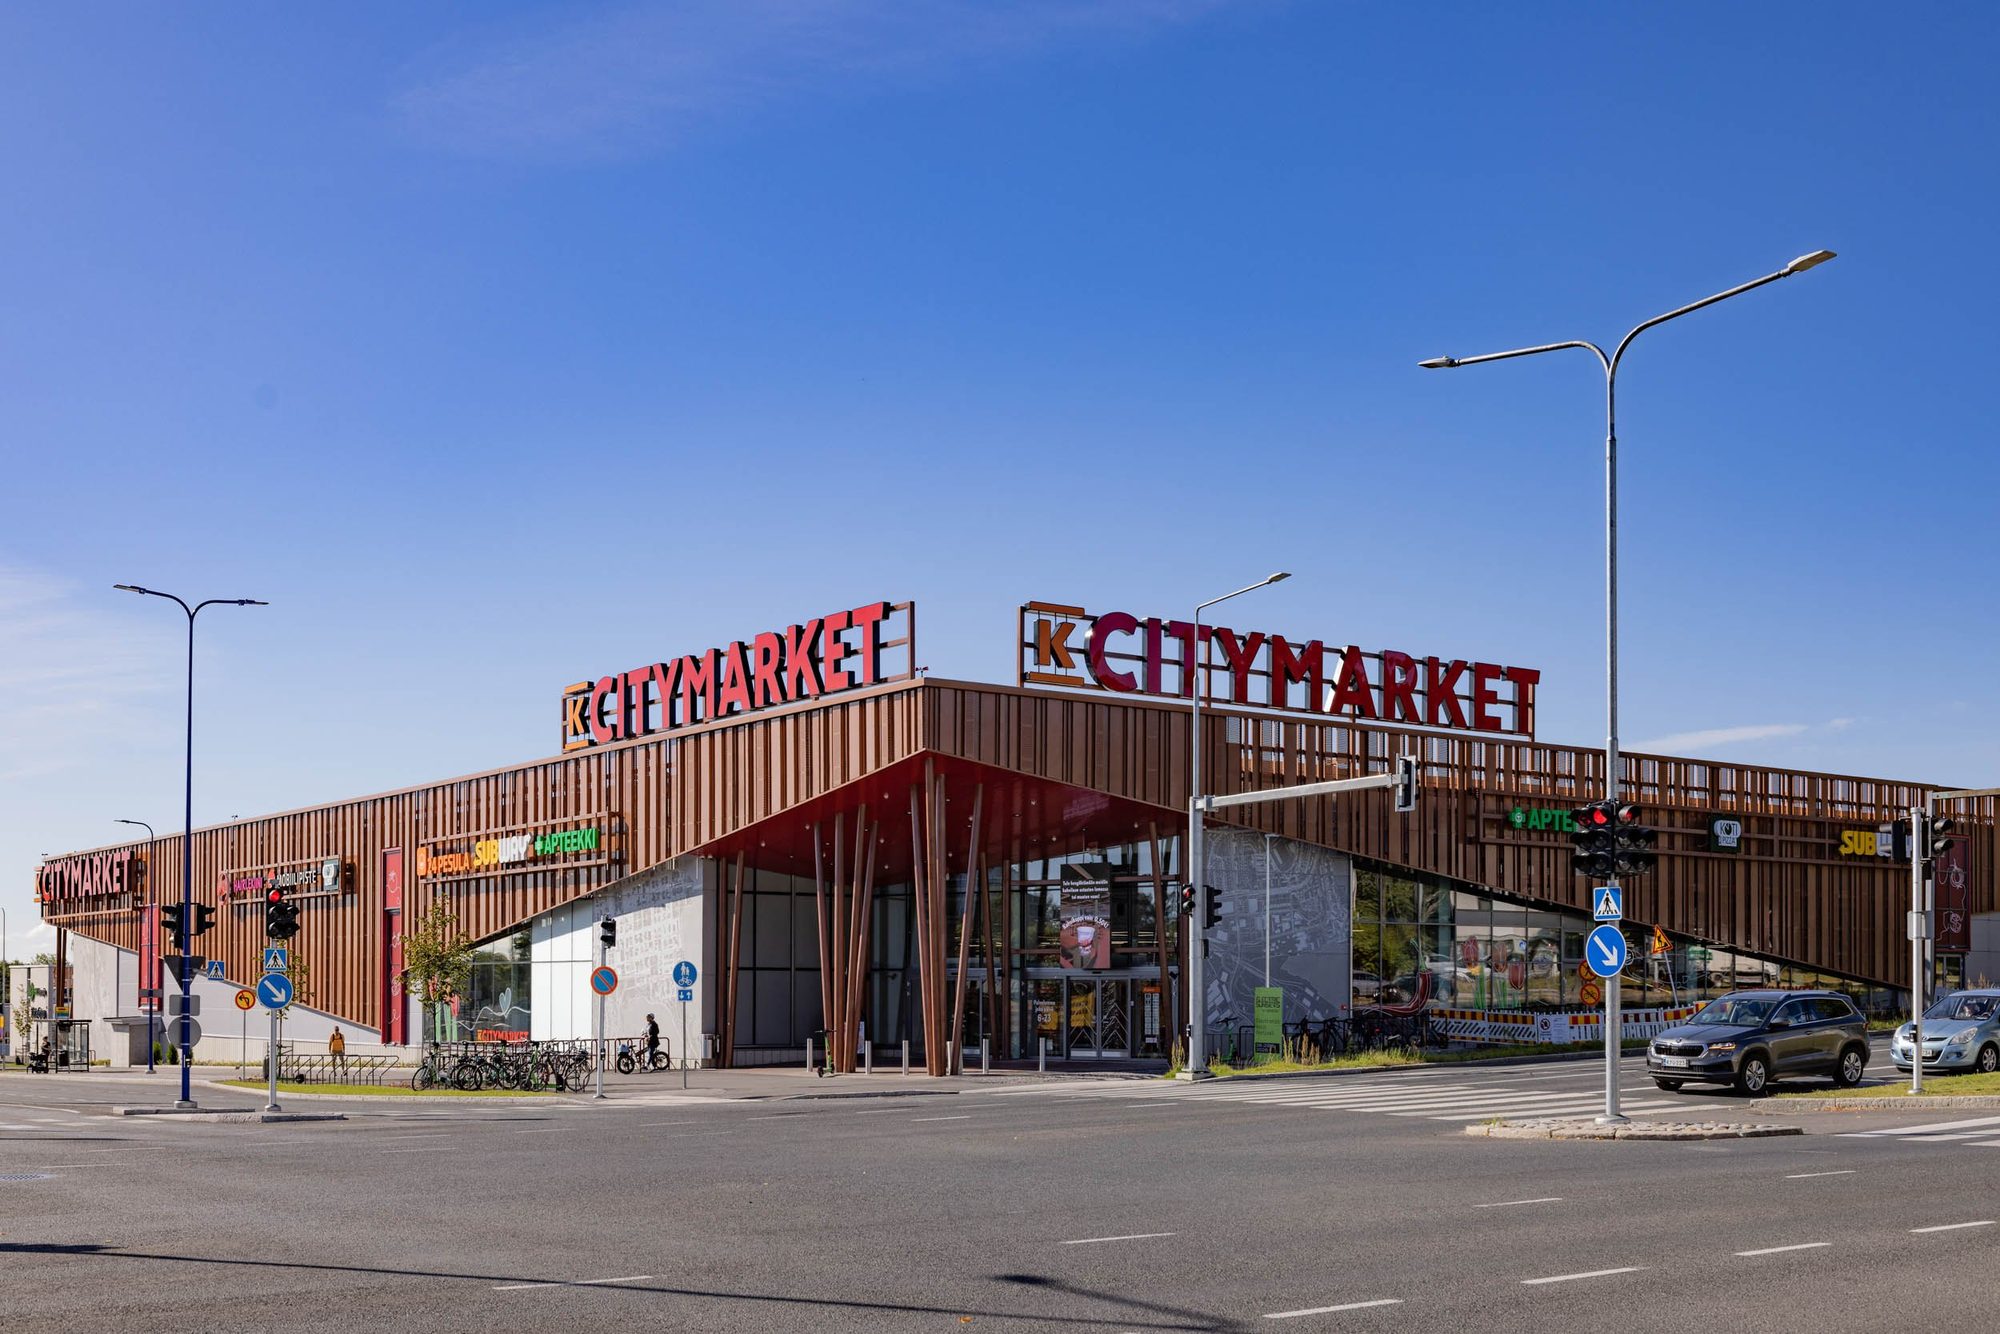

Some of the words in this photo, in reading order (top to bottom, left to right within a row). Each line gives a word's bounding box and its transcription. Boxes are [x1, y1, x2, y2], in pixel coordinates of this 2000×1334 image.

[589, 601, 890, 744] CITYMARKET
[1084, 610, 1541, 734] CITYMARKET
[1528, 808, 1577, 832] APTE
[473, 832, 531, 868] SUBWAY
[544, 828, 597, 854] APTEEKKI
[42, 850, 131, 901] CITYMARKET
[438, 851, 470, 873] PESULA
[482, 1029, 529, 1041] CITYMARKET
